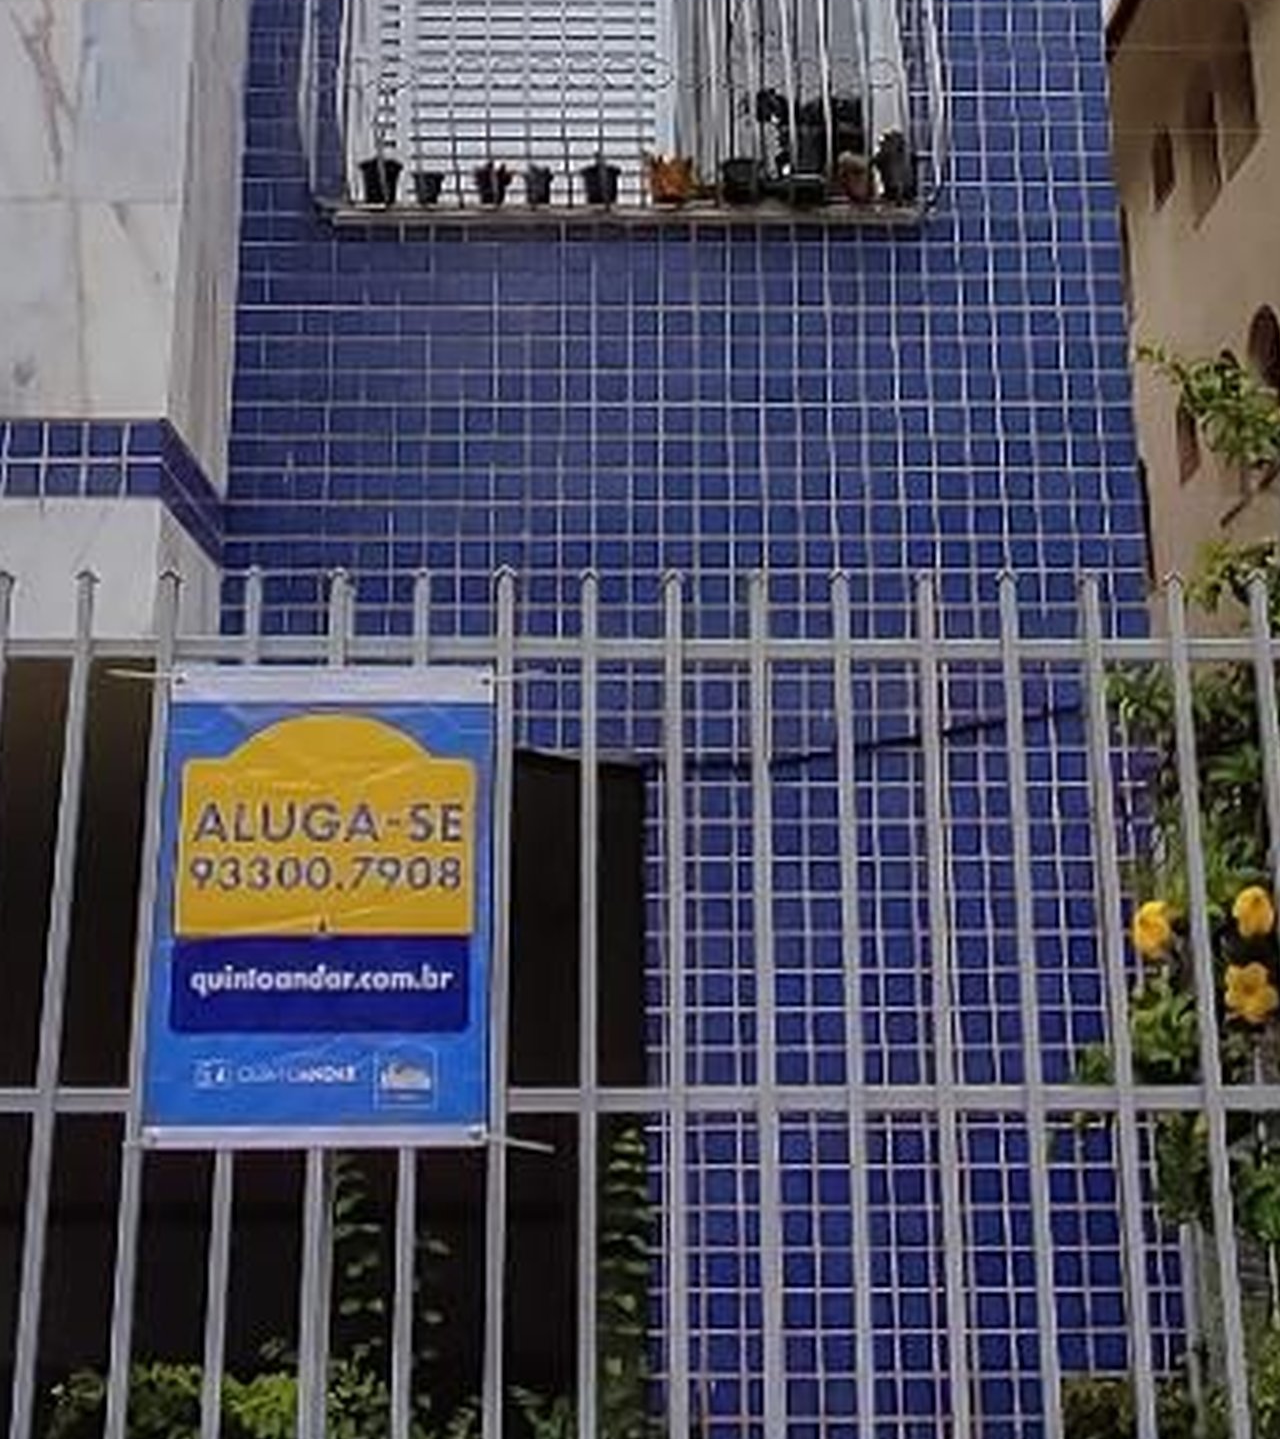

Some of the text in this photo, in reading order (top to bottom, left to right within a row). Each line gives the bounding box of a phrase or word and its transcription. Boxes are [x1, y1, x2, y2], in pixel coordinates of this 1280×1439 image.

[192, 801, 464, 844] ALUGA-SE
[189, 855, 462, 892] 93300.7908
[190, 963, 454, 998] quintoandar.com.br
